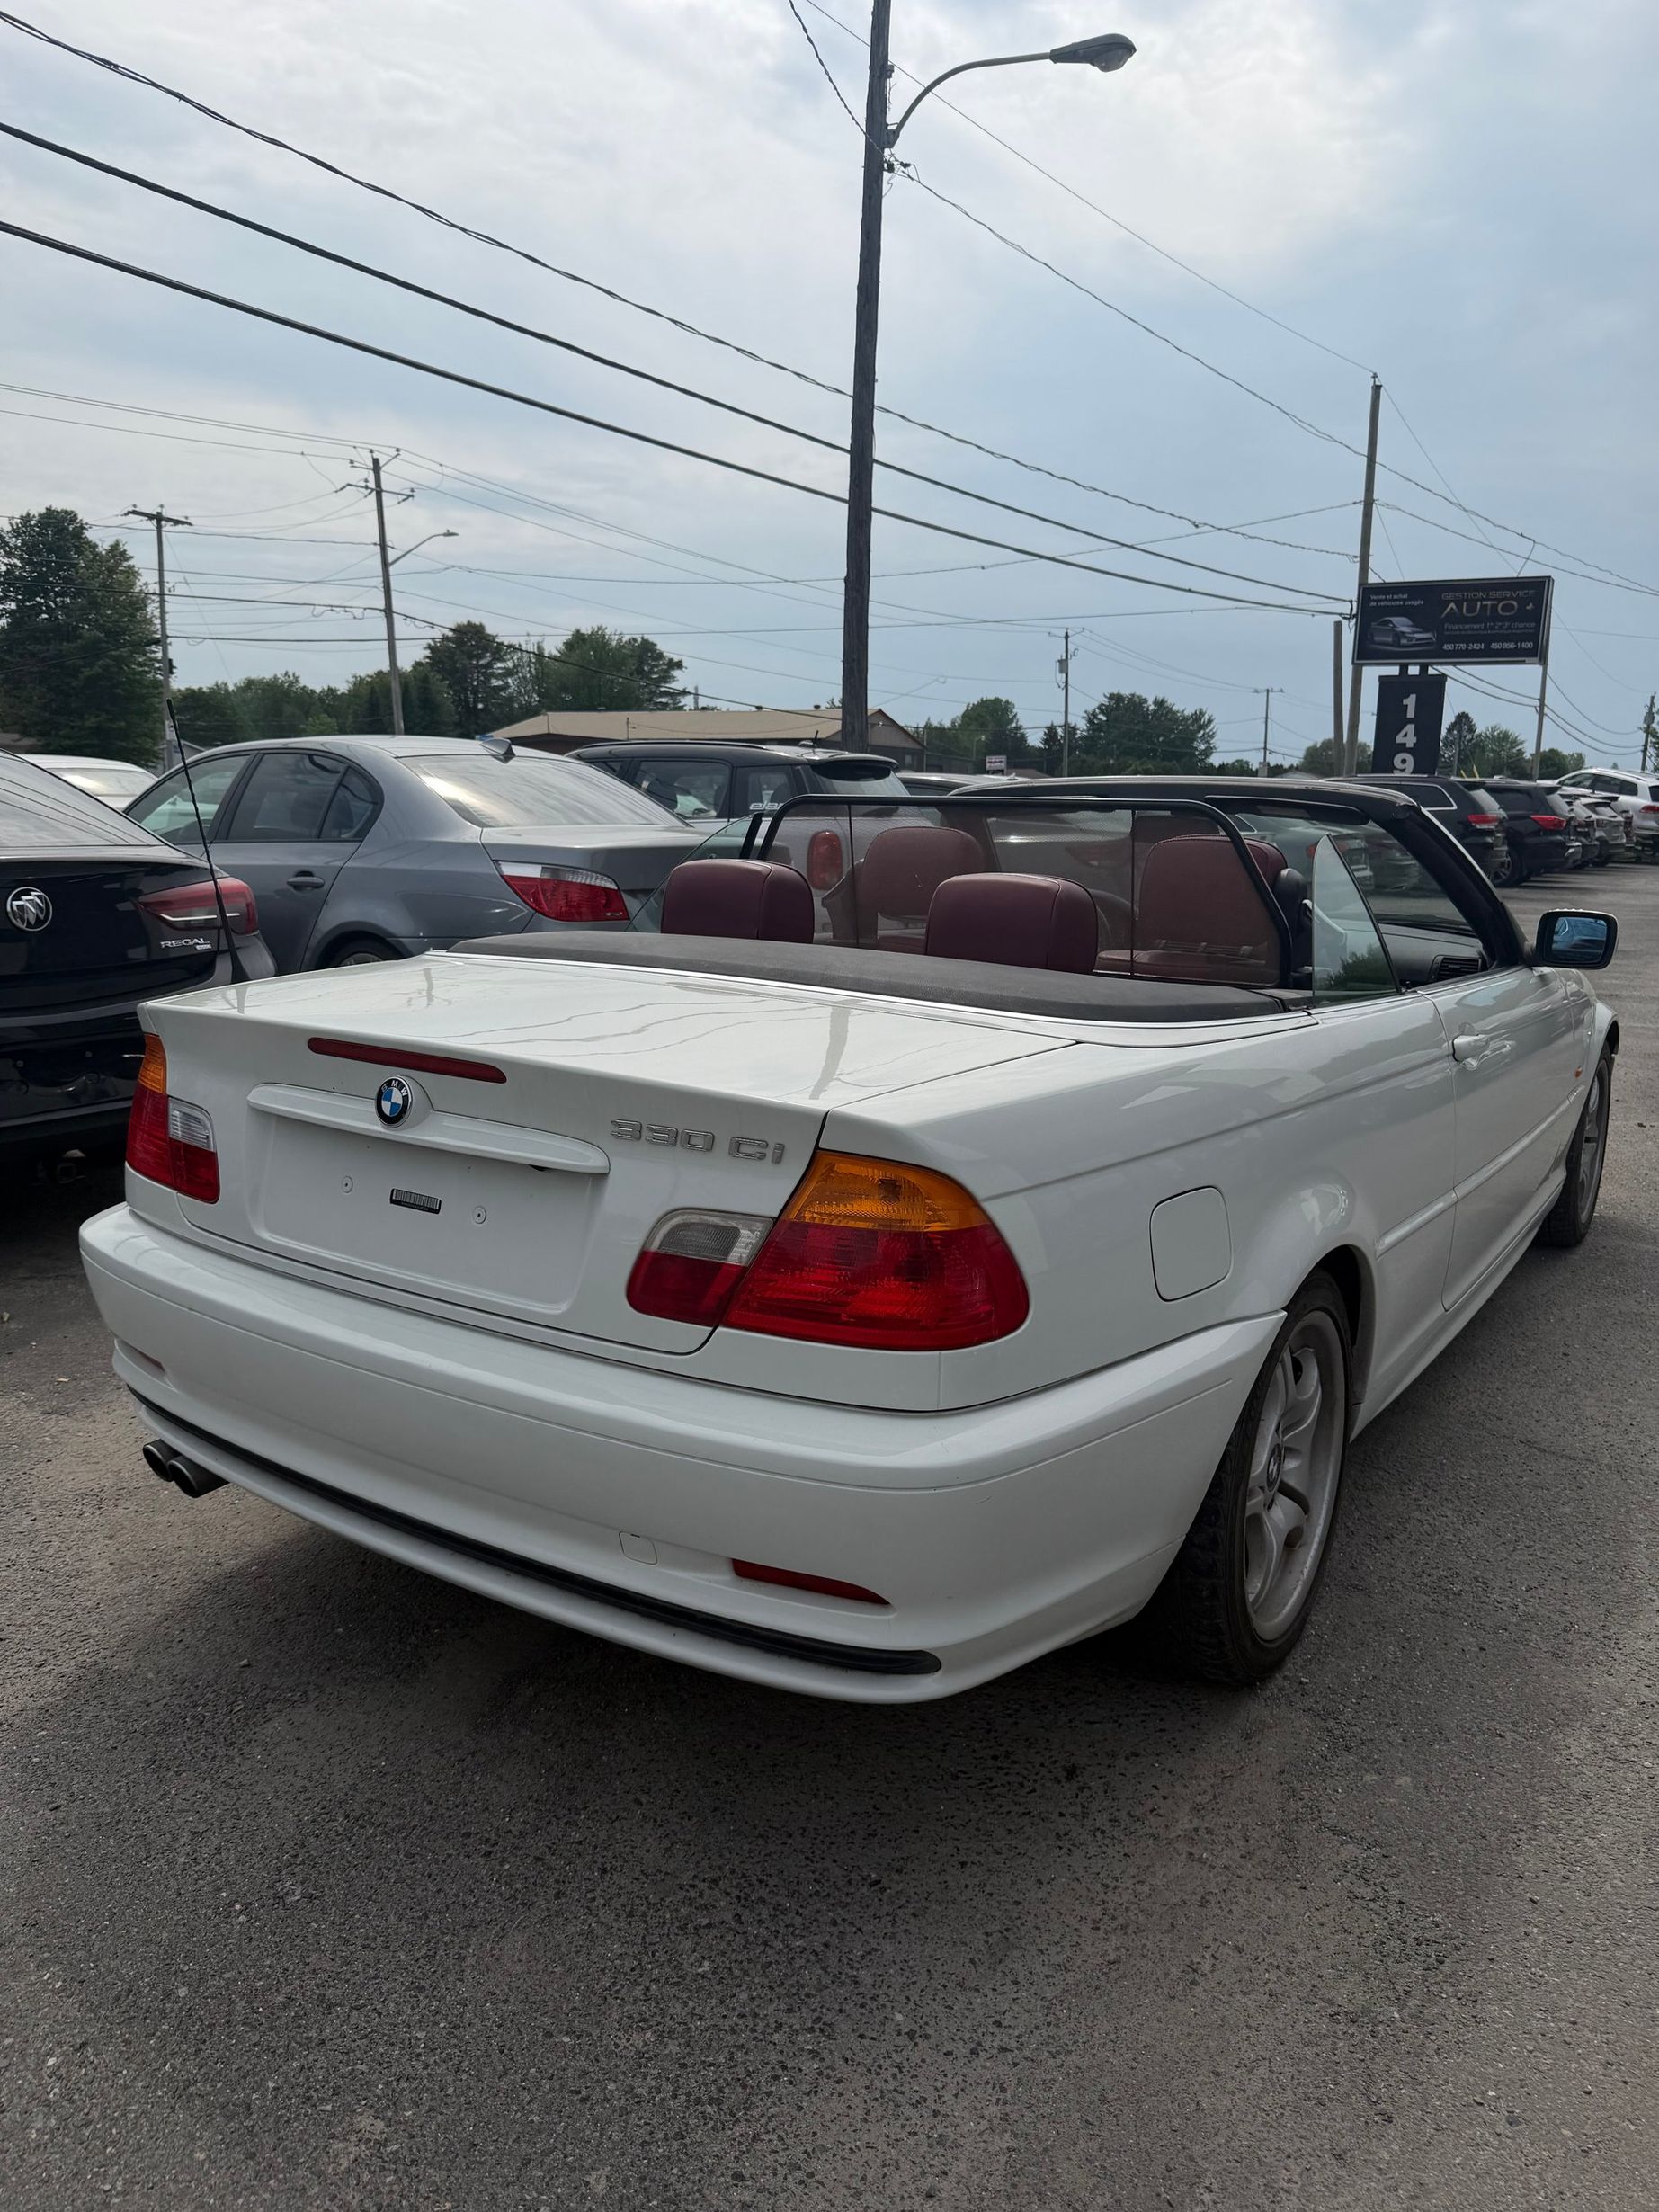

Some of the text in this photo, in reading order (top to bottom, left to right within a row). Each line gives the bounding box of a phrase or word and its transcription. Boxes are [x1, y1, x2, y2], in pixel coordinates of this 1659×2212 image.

[1441, 592, 1486, 601] GESTION
[1440, 600, 1519, 619] AUTO
[160, 938, 210, 949] REGAL
[381, 1079, 408, 1096] BMW
[611, 1119, 786, 1165] 330 Ci
